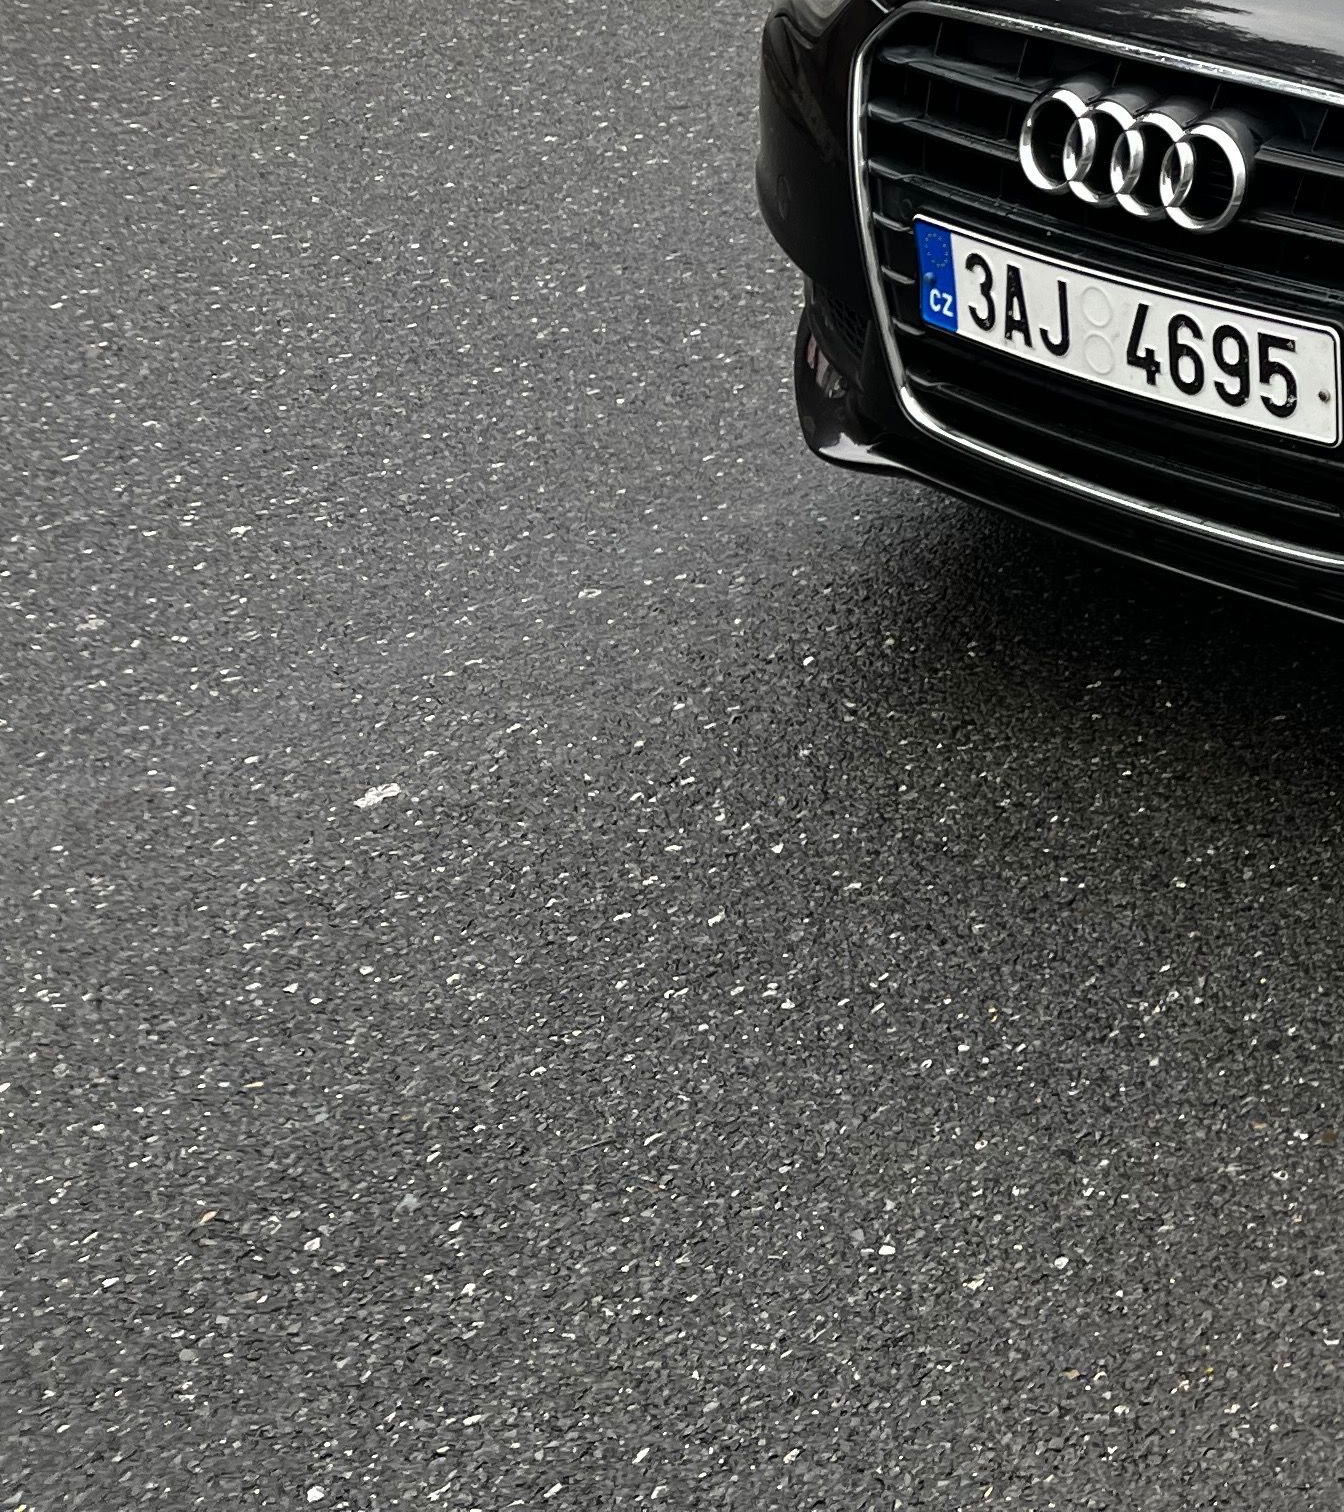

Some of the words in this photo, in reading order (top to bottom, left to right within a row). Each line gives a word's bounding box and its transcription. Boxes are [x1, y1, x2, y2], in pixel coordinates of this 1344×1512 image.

[929, 288, 954, 318] CZ
[965, 252, 1070, 357] 3AJ
[1126, 303, 1298, 419] 4695
